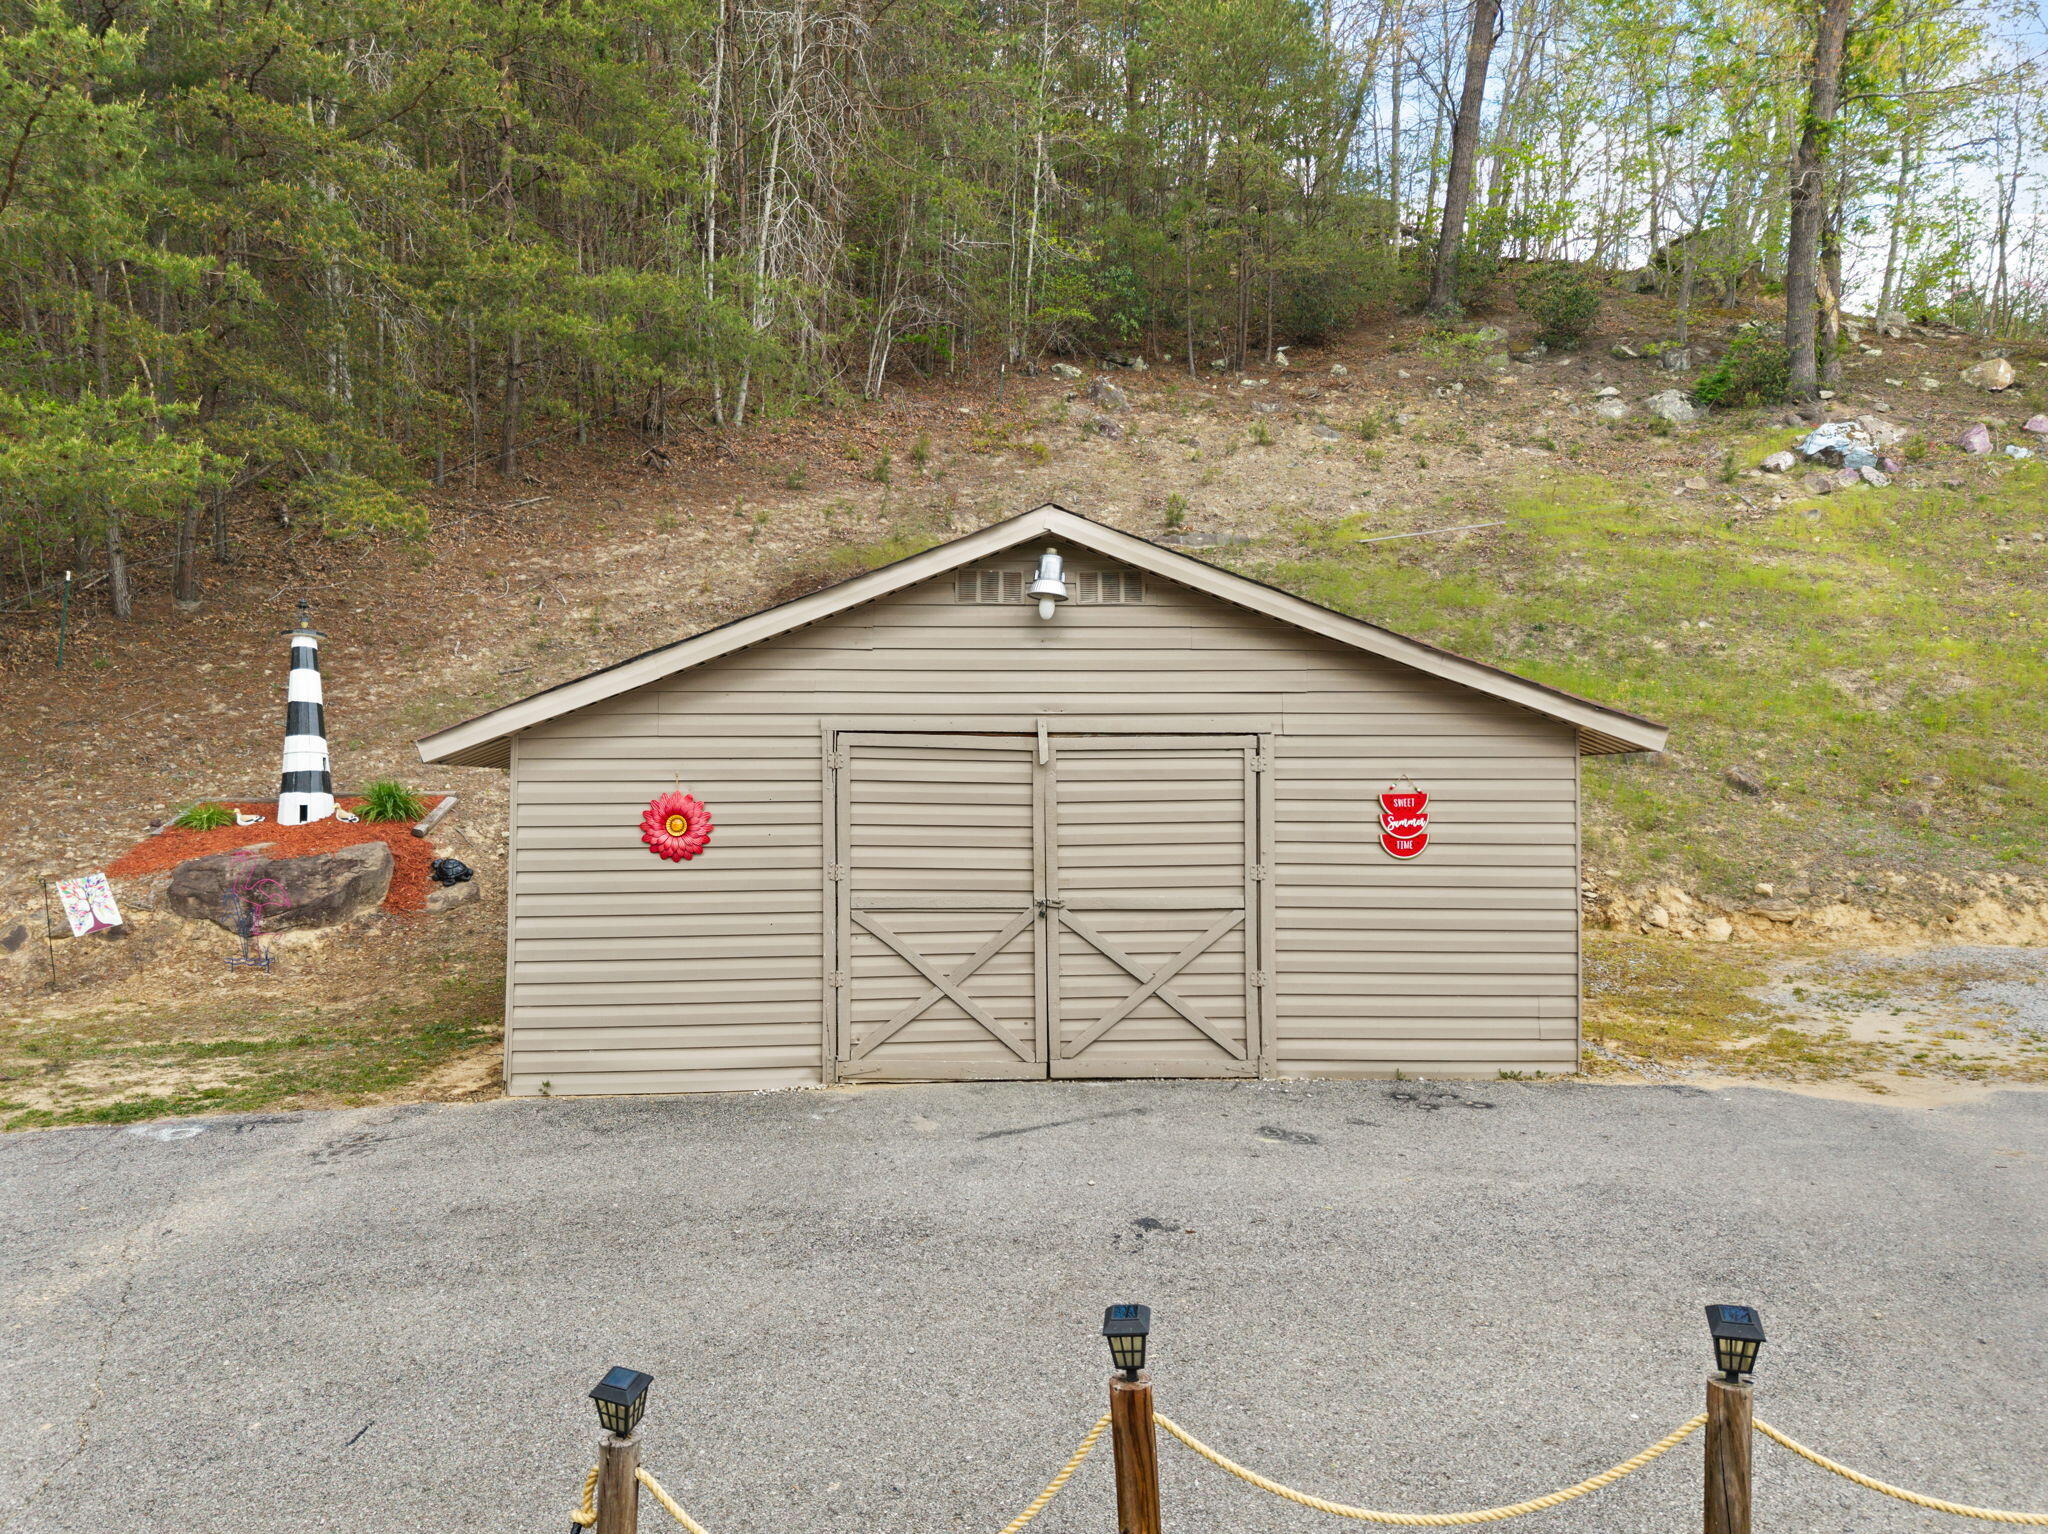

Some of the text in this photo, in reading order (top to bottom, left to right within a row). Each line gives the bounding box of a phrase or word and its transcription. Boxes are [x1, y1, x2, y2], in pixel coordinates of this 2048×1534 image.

[1393, 798, 1415, 808] SWEET
[1387, 815, 1426, 831] Summer
[1396, 840, 1413, 850] TIME
